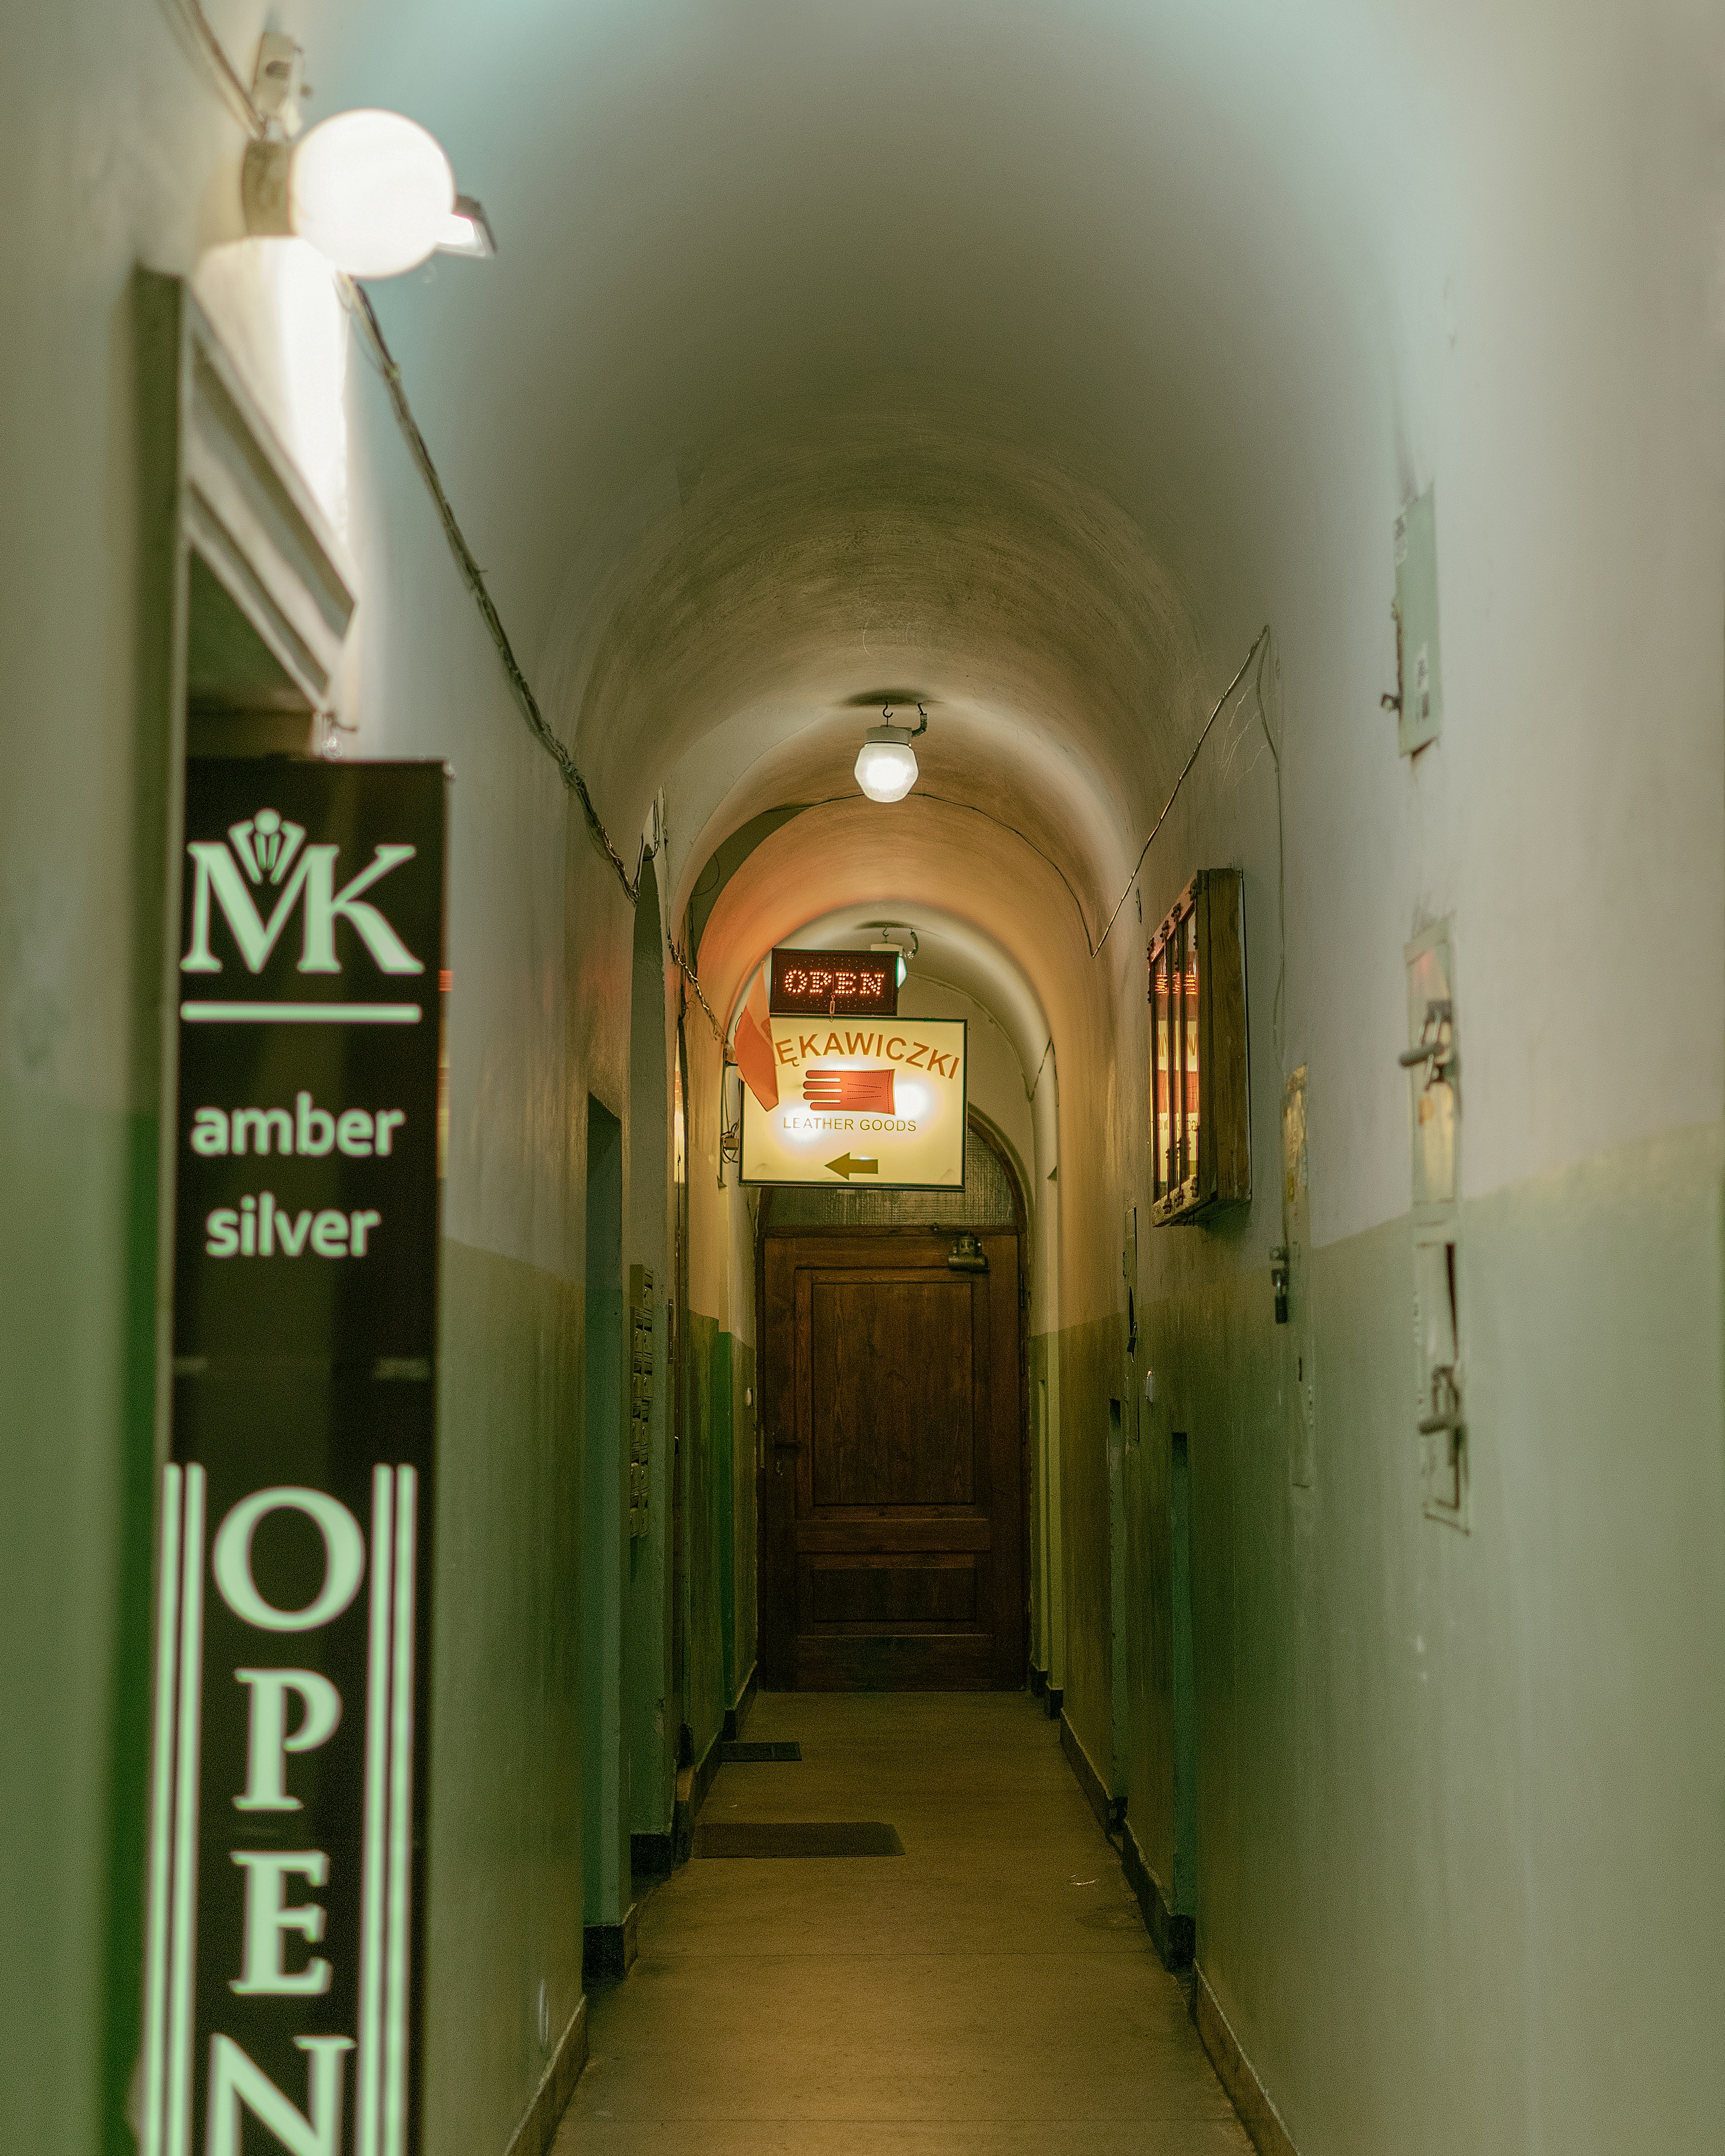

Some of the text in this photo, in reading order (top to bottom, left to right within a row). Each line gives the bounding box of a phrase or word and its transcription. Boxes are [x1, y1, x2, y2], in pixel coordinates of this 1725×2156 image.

[179, 841, 426, 976] MK
[784, 969, 885, 995] OPEN
[773, 1031, 960, 1080] ĘKAWICZKI
[191, 1090, 406, 1157] amber
[783, 1116, 917, 1132] LEATHER GOODS
[205, 1190, 381, 1258] silver
[206, 1485, 366, 2156] OPEN
